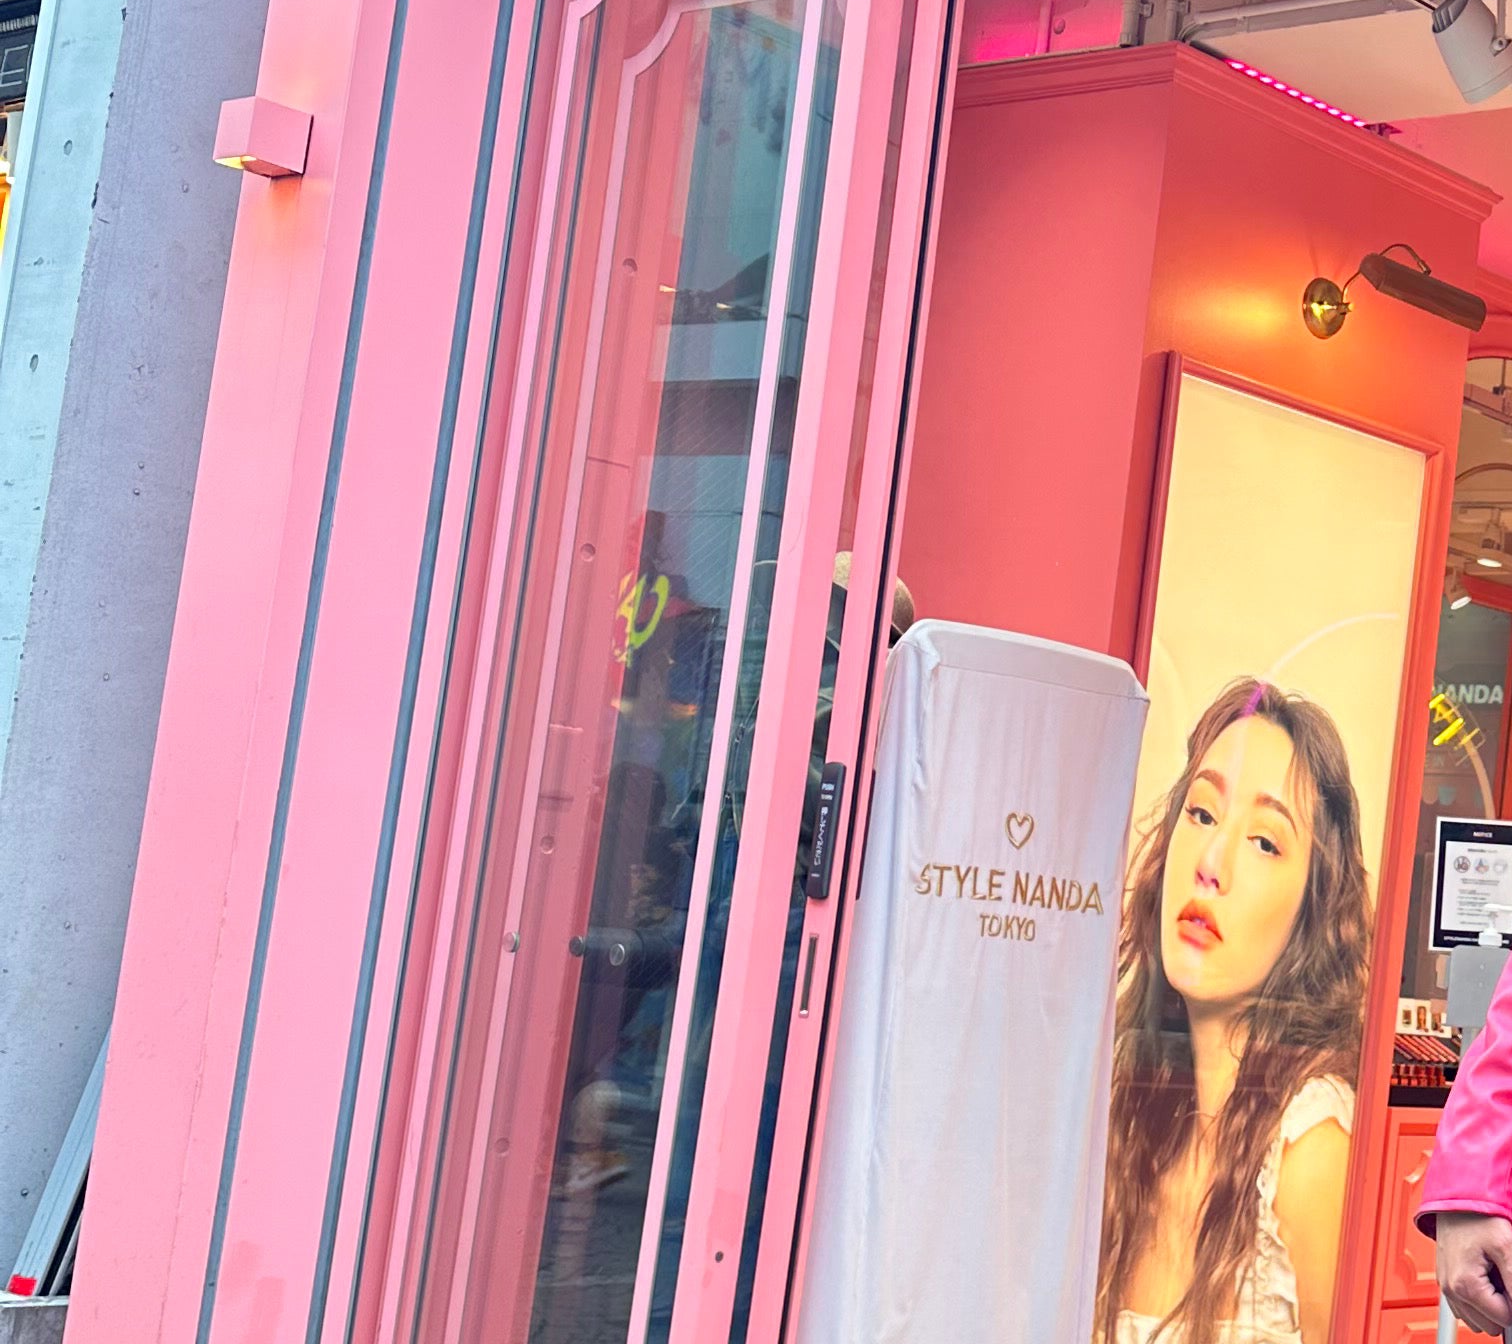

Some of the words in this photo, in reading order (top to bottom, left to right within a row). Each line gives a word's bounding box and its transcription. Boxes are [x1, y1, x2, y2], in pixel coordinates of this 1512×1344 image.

[915, 862, 1005, 901] STYLE
[1012, 870, 1104, 915] NANDA
[979, 913, 1036, 941] TOKYO
